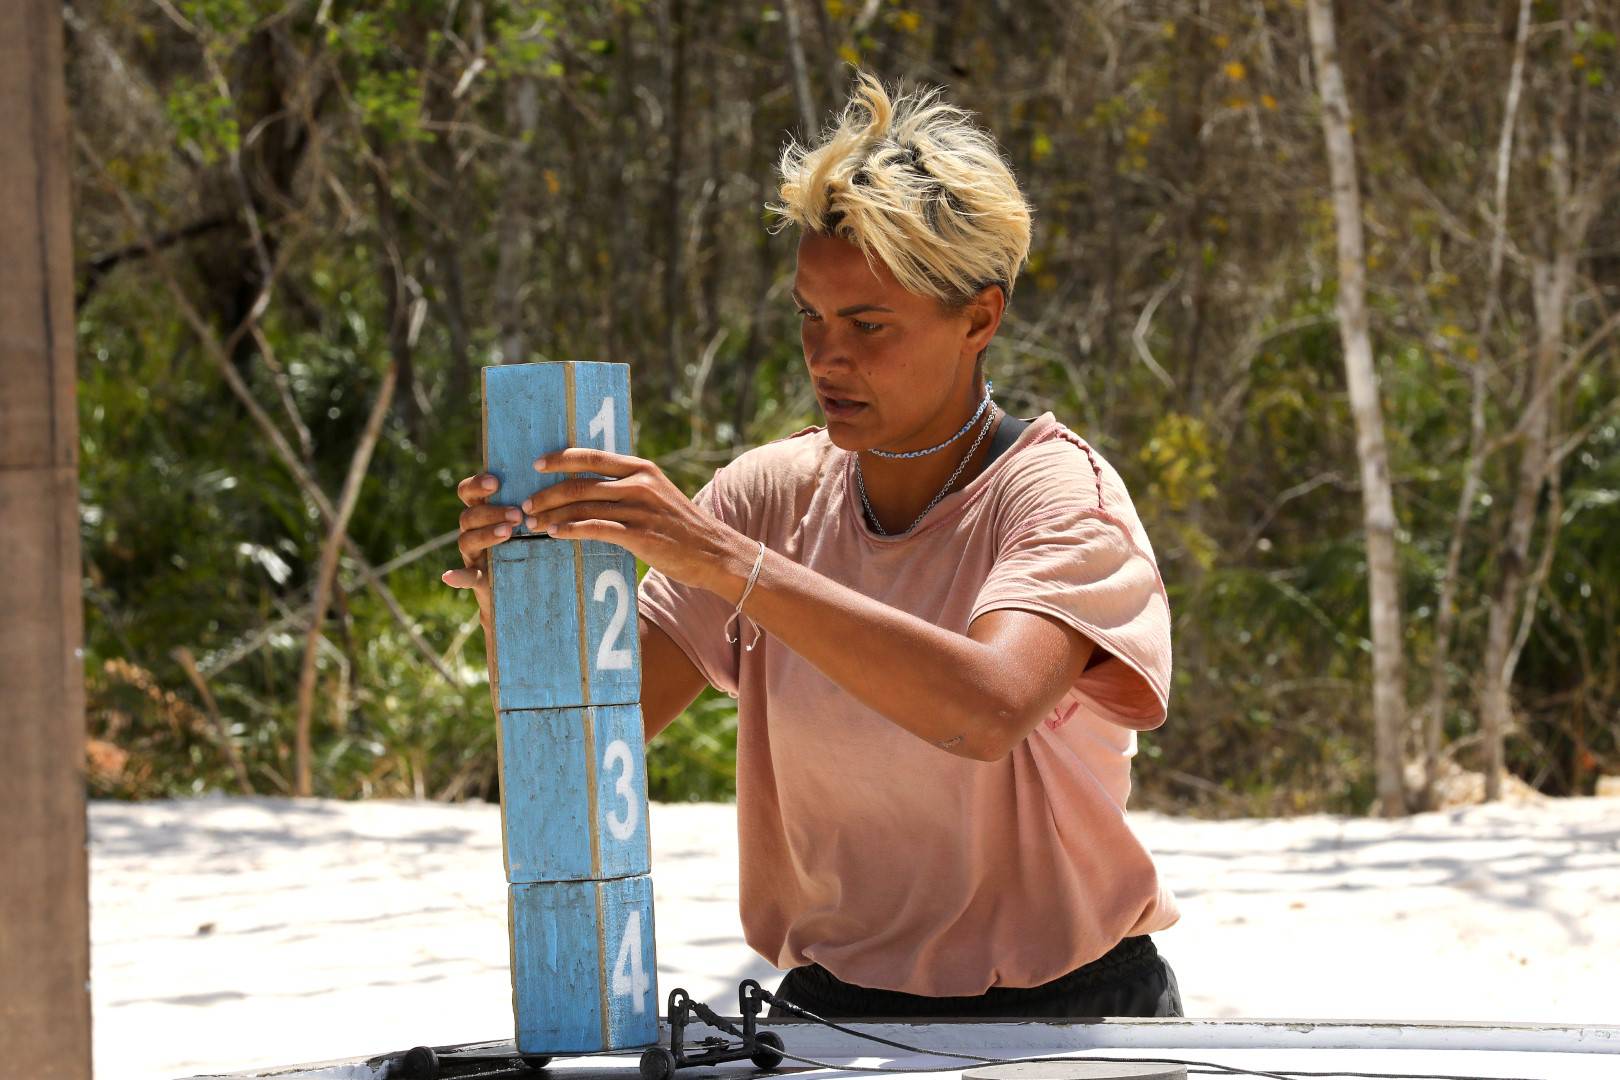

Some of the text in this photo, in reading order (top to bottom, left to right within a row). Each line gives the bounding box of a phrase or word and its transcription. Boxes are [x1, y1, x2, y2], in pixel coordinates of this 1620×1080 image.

[589, 396, 616, 454] 1
[593, 569, 632, 670] 2
[603, 740, 638, 841] 3
[611, 911, 649, 1013] 4
